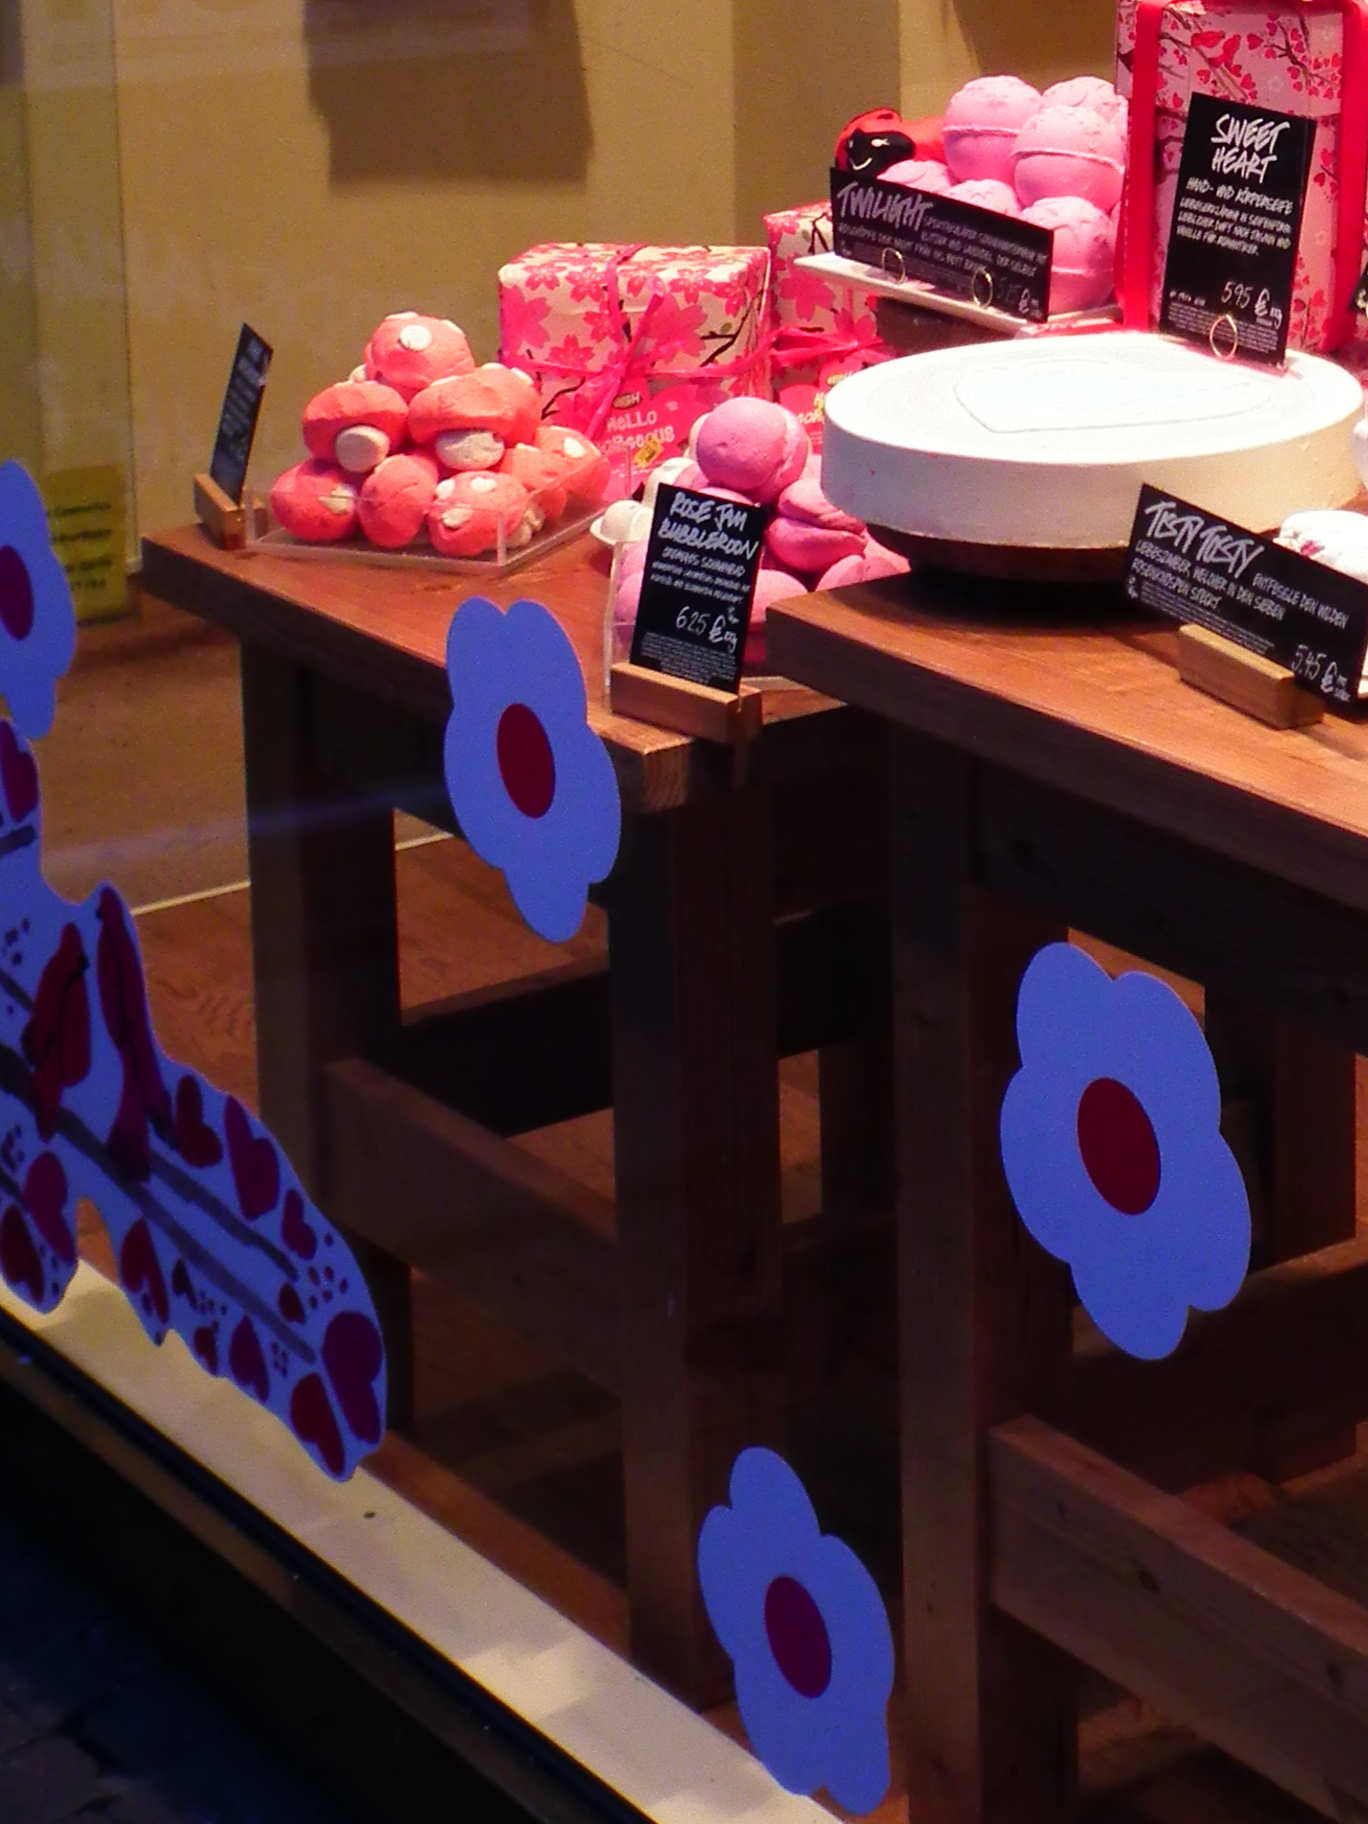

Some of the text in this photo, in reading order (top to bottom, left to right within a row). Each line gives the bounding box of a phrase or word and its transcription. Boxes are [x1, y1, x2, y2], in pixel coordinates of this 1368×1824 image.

[1211, 113, 1291, 154] SWEET
[1211, 147, 1278, 184] HEART
[837, 180, 934, 232] TWILIGHT
[669, 490, 748, 531] ROSE JAM
[658, 518, 760, 560] BUBBLEROON
